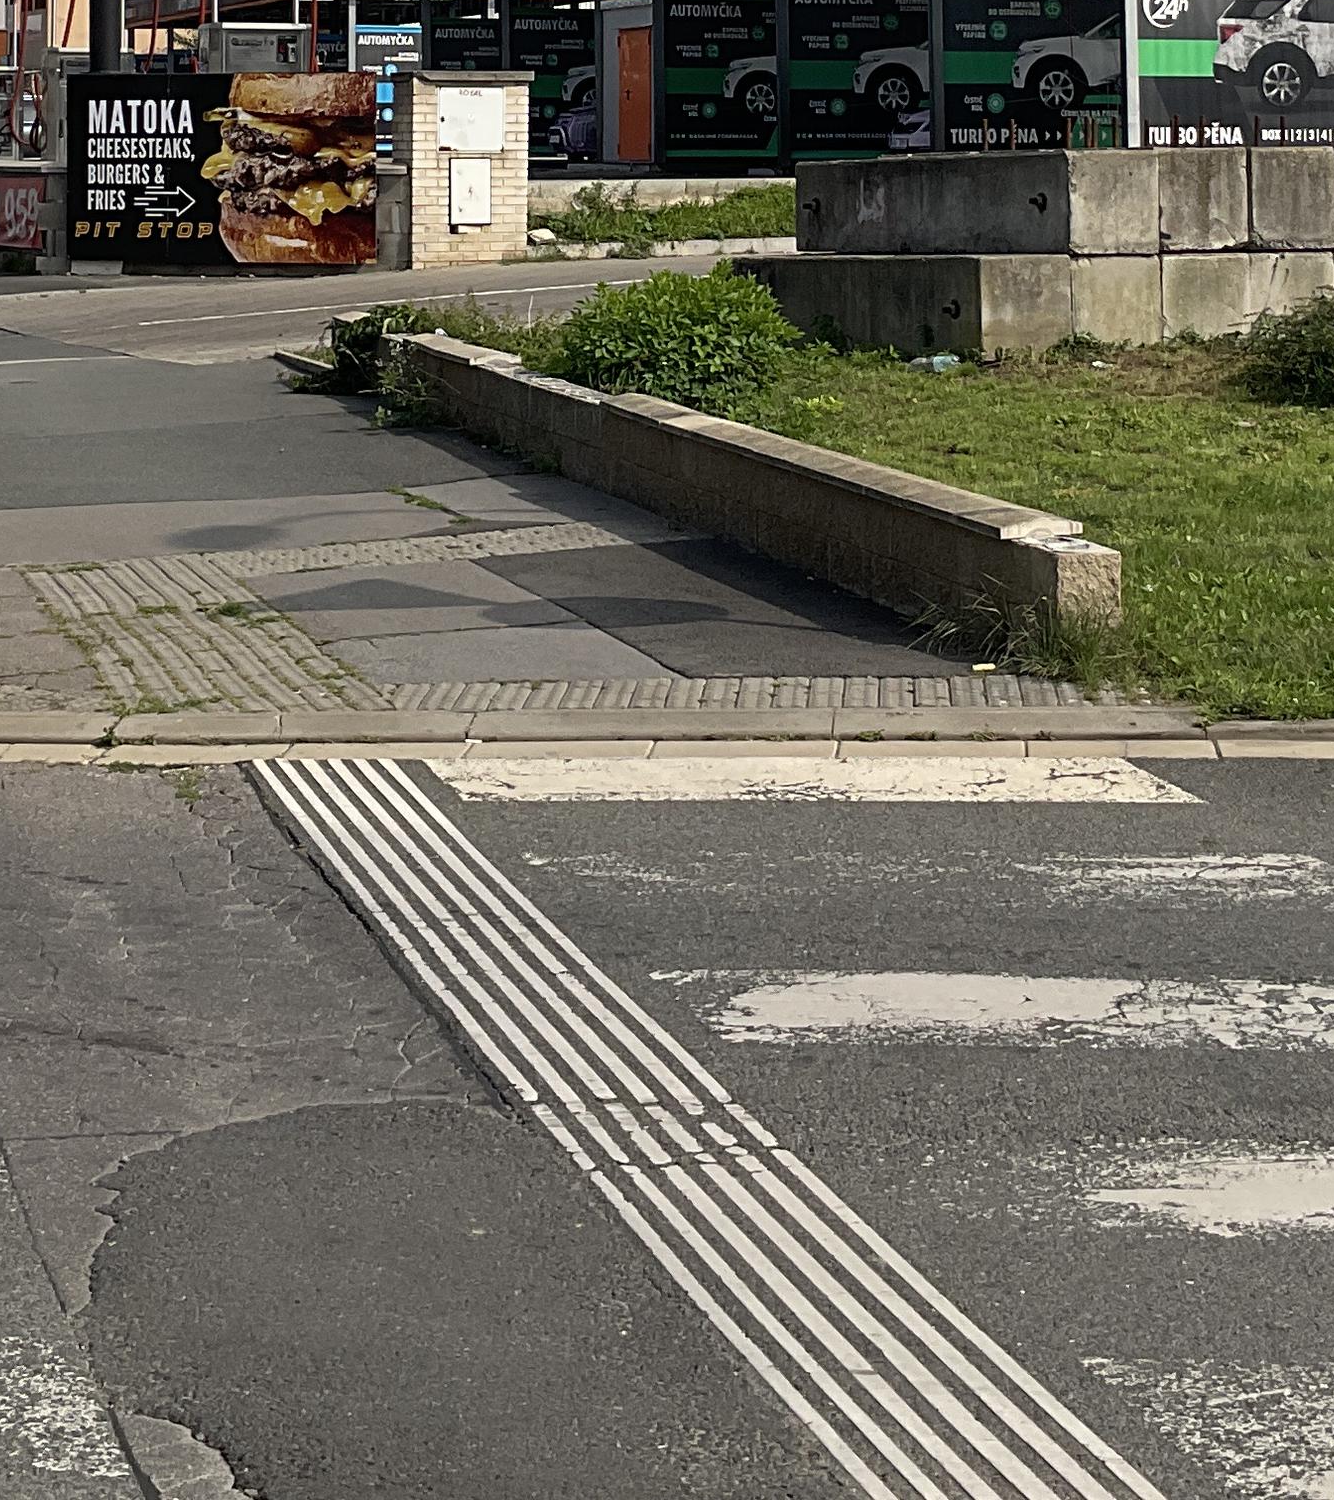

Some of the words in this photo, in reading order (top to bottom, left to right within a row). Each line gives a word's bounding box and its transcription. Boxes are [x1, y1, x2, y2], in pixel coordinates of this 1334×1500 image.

[669, 2, 742, 18] AUTOMYČKA
[434, 26, 495, 40] AUTOMYČKA
[514, 16, 579, 32] AUTOMYČKA
[357, 33, 415, 46] AUTOMYČKA
[87, 99, 194, 135] MATOKA
[1261, 129, 1281, 141] BOX
[87, 138, 196, 162] CHEESESTEAKS,
[87, 163, 150, 185] BURGERS
[154, 164, 165, 185] &
[87, 189, 126, 211] FRIES
[4, 187, 39, 240] 959
[74, 221, 121, 238] PIT
[136, 221, 214, 239] STOP
